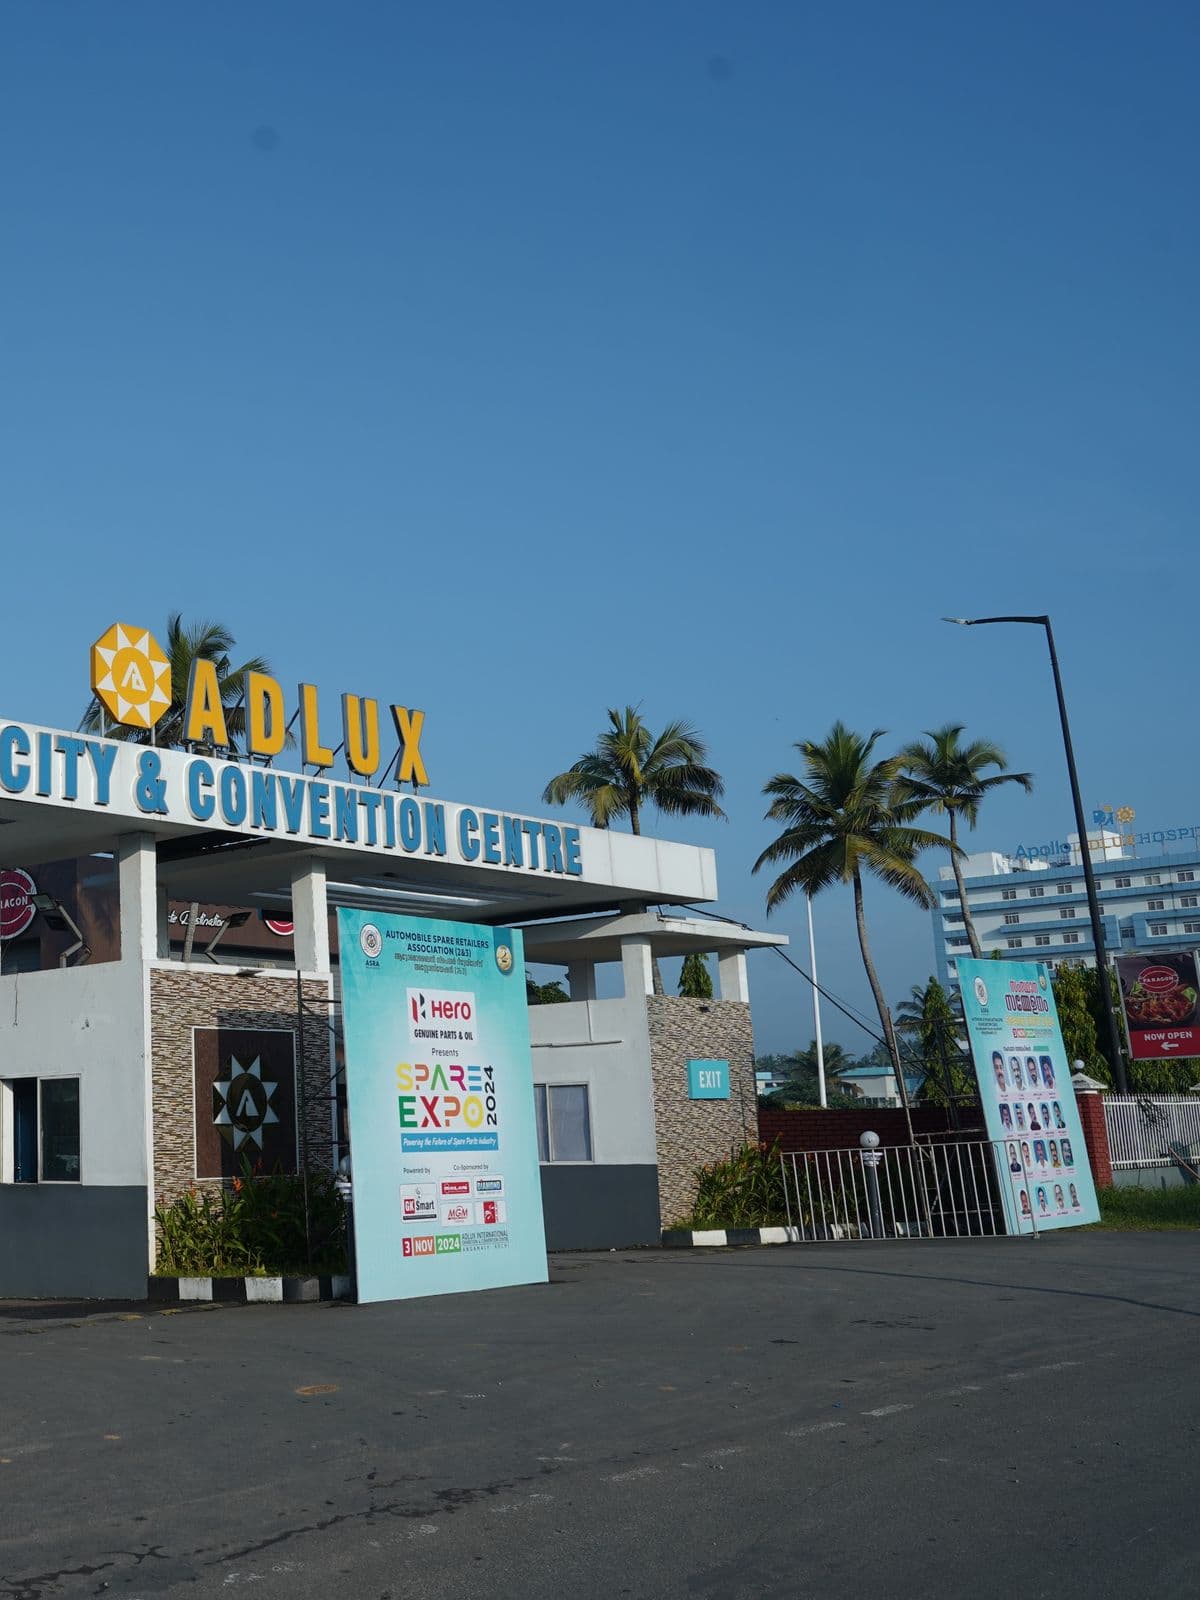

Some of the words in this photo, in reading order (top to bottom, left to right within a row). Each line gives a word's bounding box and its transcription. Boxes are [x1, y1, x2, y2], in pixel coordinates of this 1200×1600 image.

[183, 657, 430, 788] ADLUX
[135, 750, 169, 815] &
[187, 758, 447, 857] CONVENTION
[459, 806, 583, 875] CENTRE
[1015, 840, 1071, 864] Apollo
[1073, 834, 1136, 852] DLUX
[0, 896, 28, 909] AGON
[385, 930, 431, 943] AUTOMOBILE
[432, 934, 454, 945] SPARE
[456, 938, 489, 949] RETAILERS
[407, 943, 454, 956] ASSOCIATION
[455, 948, 471, 958] (2&3)
[431, 1000, 471, 1020] Hero
[414, 1029, 438, 1039] GENUINE
[440, 1030, 457, 1040] PARTS
[458, 1031, 463, 1040] &
[464, 1031, 473, 1040] OIL
[1144, 1033, 1165, 1041] NOW
[1167, 1031, 1193, 1039] OPEN
[431, 1047, 459, 1057] Presents
[395, 1062, 482, 1092] SPARE
[699, 1070, 721, 1088] EXIT
[483, 1065, 498, 1126] 2024
[398, 1095, 484, 1128] EXPO
[424, 1167, 431, 1175] by
[416, 1200, 435, 1211] Smart
[448, 1207, 468, 1218] MGM
[404, 1240, 410, 1253] 3
[415, 1239, 433, 1252] NOV
[438, 1237, 460, 1251] 2024
